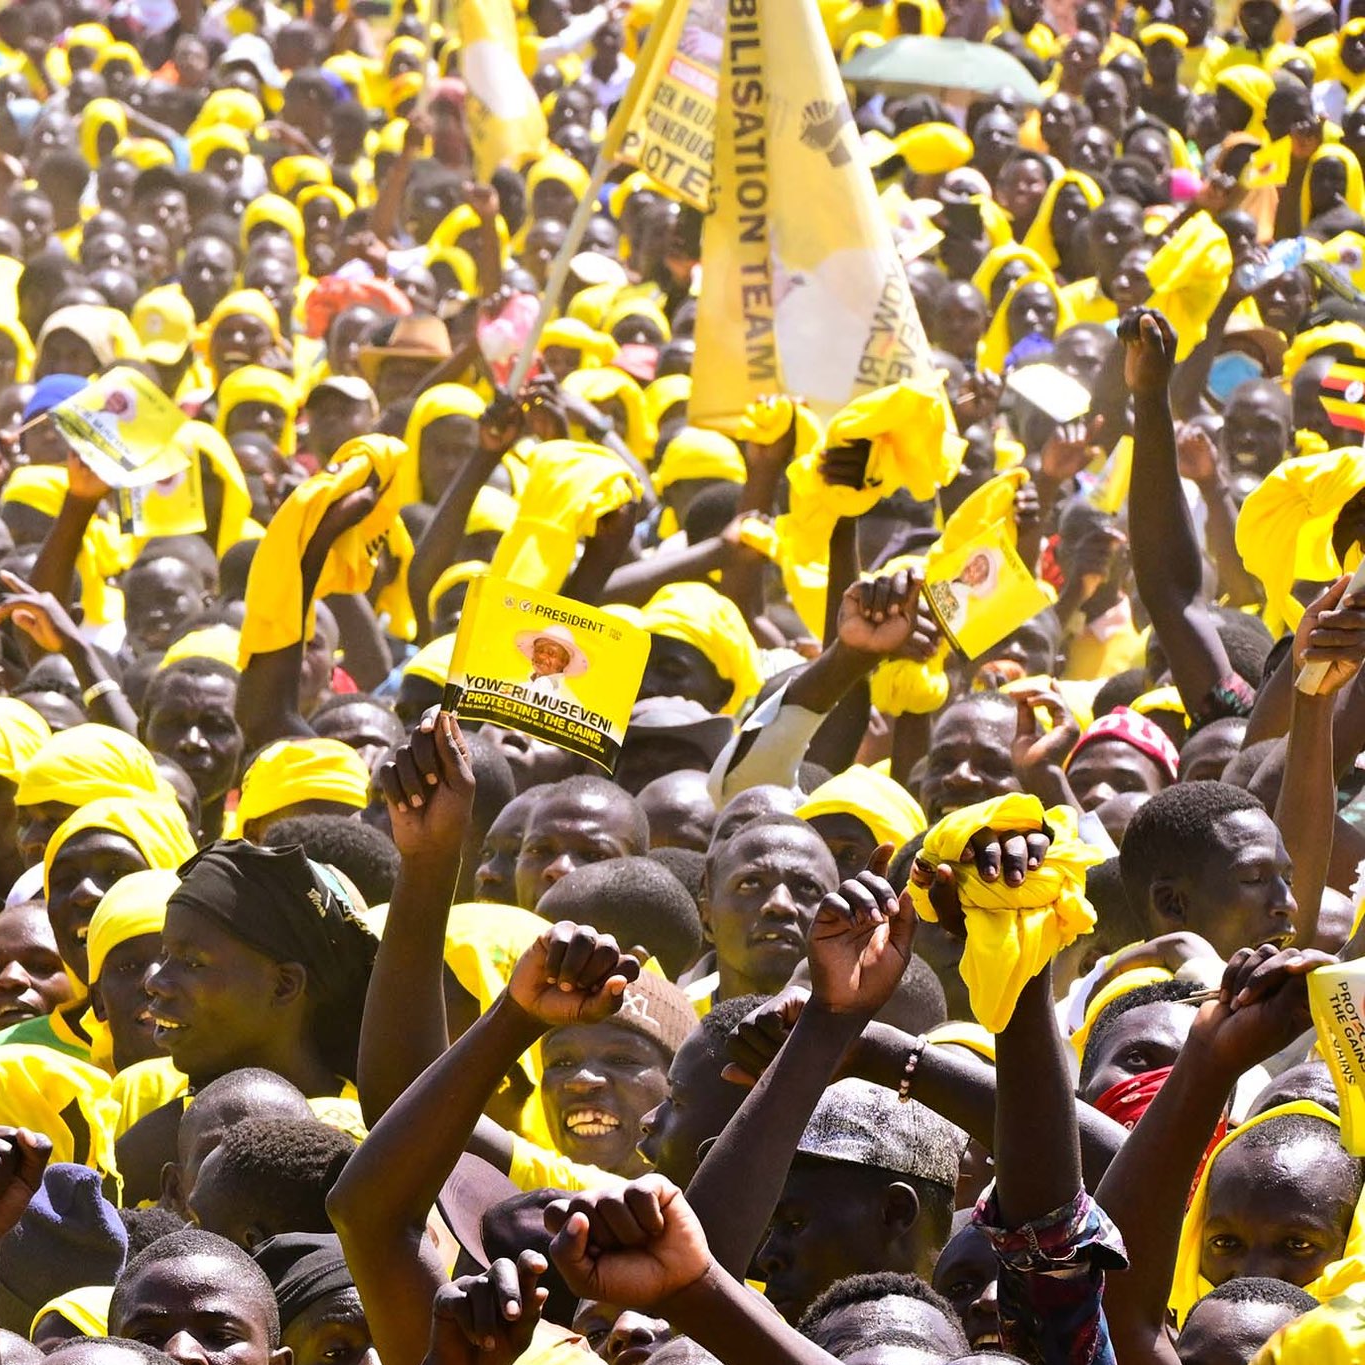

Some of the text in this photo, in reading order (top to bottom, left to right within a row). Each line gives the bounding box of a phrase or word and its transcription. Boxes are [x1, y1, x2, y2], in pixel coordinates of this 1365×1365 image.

[739, 257, 777, 382] TEAM
[535, 604, 605, 634] PRESIDENT
[466, 692, 602, 745] PROTECTING THE GAINS
[534, 691, 612, 733] MUSEVENI
[1329, 993, 1348, 1025] THE
